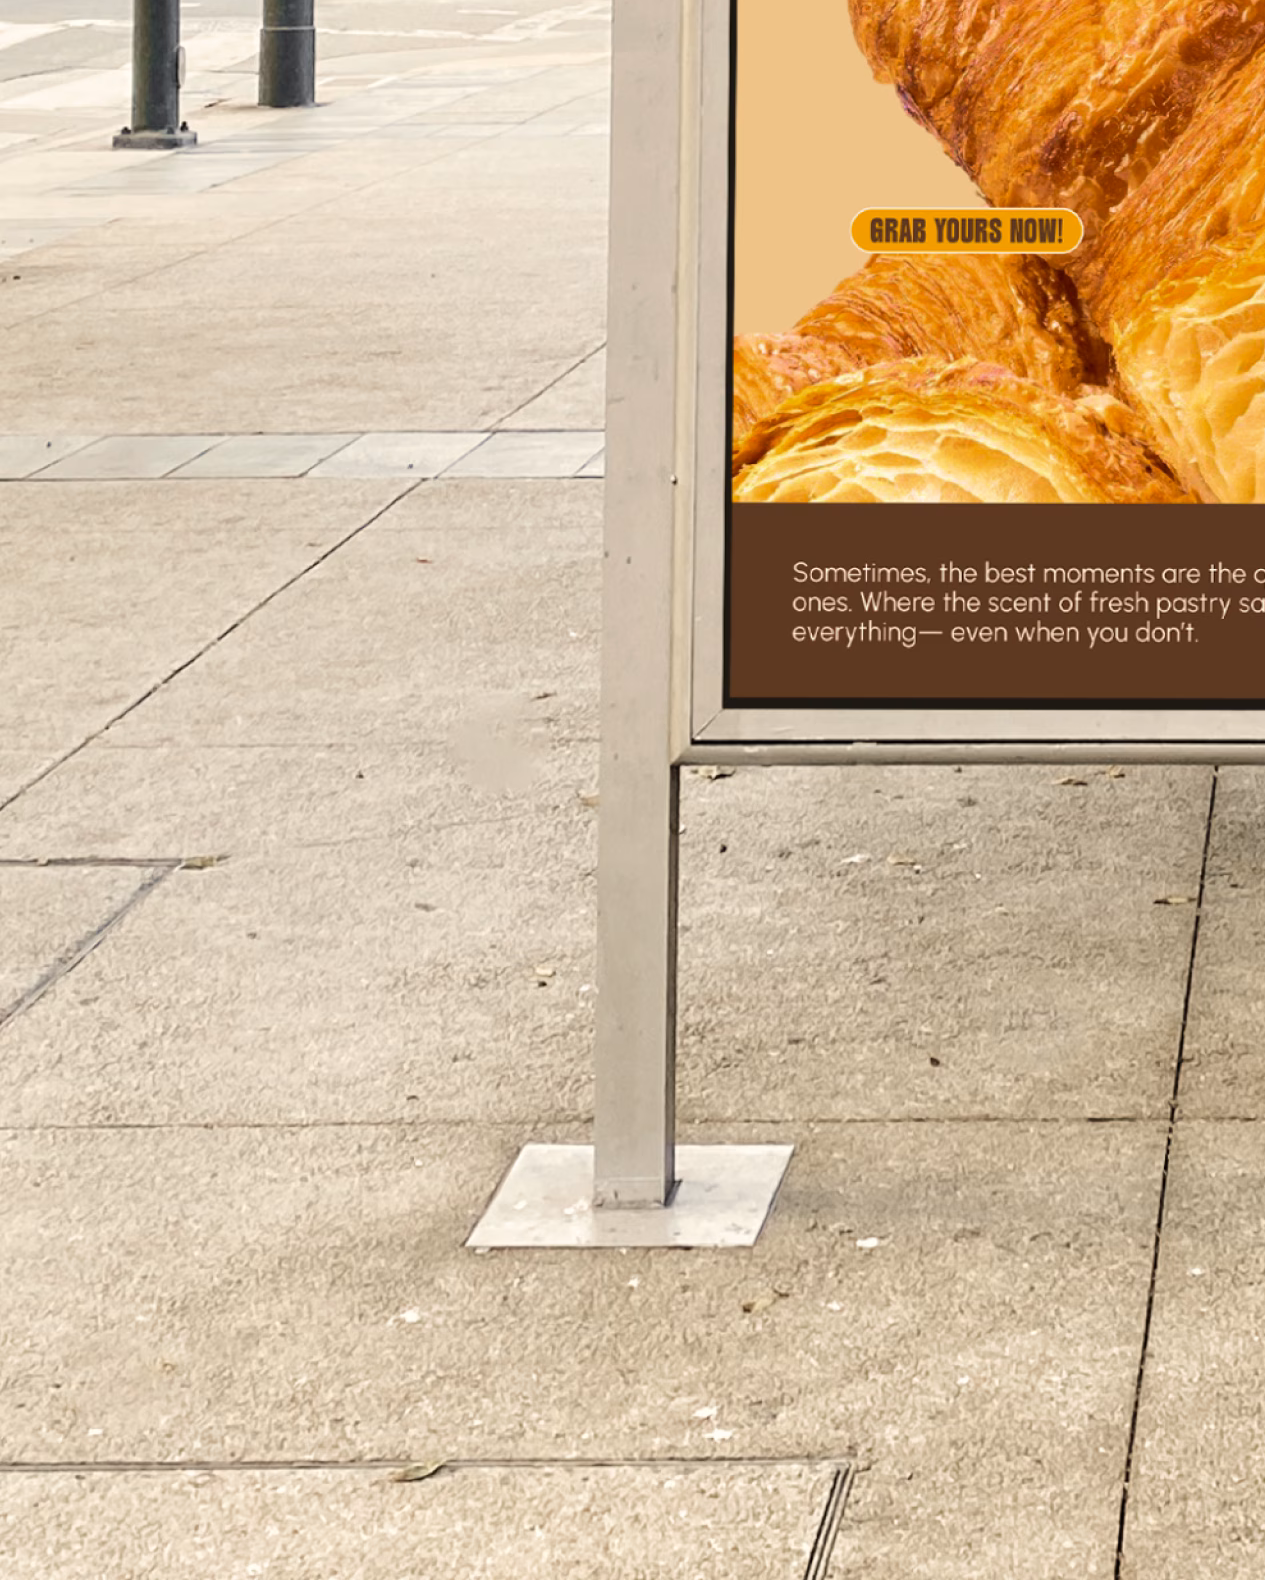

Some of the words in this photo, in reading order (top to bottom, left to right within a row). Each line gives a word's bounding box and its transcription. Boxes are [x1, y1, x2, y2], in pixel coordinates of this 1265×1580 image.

[869, 217, 927, 243] GRAB
[934, 217, 1003, 244] YOURS
[1009, 217, 1063, 244] NOW!
[793, 560, 932, 584] Sometimes,
[939, 560, 978, 584] the
[984, 560, 1037, 584] best
[1043, 563, 1156, 584] moments
[1161, 567, 1201, 584] are
[1208, 560, 1247, 584] the
[791, 595, 853, 613] ones.
[859, 589, 936, 613] Where
[942, 589, 982, 613] the
[988, 592, 1052, 614] scent
[1058, 589, 1083, 614] of
[1089, 589, 1150, 614] fresh
[1156, 592, 1232, 620] pastry
[950, 625, 1008, 643] even
[1014, 619, 1080, 643] when
[1086, 626, 1129, 650] you
[1135, 619, 1199, 644] don't.
